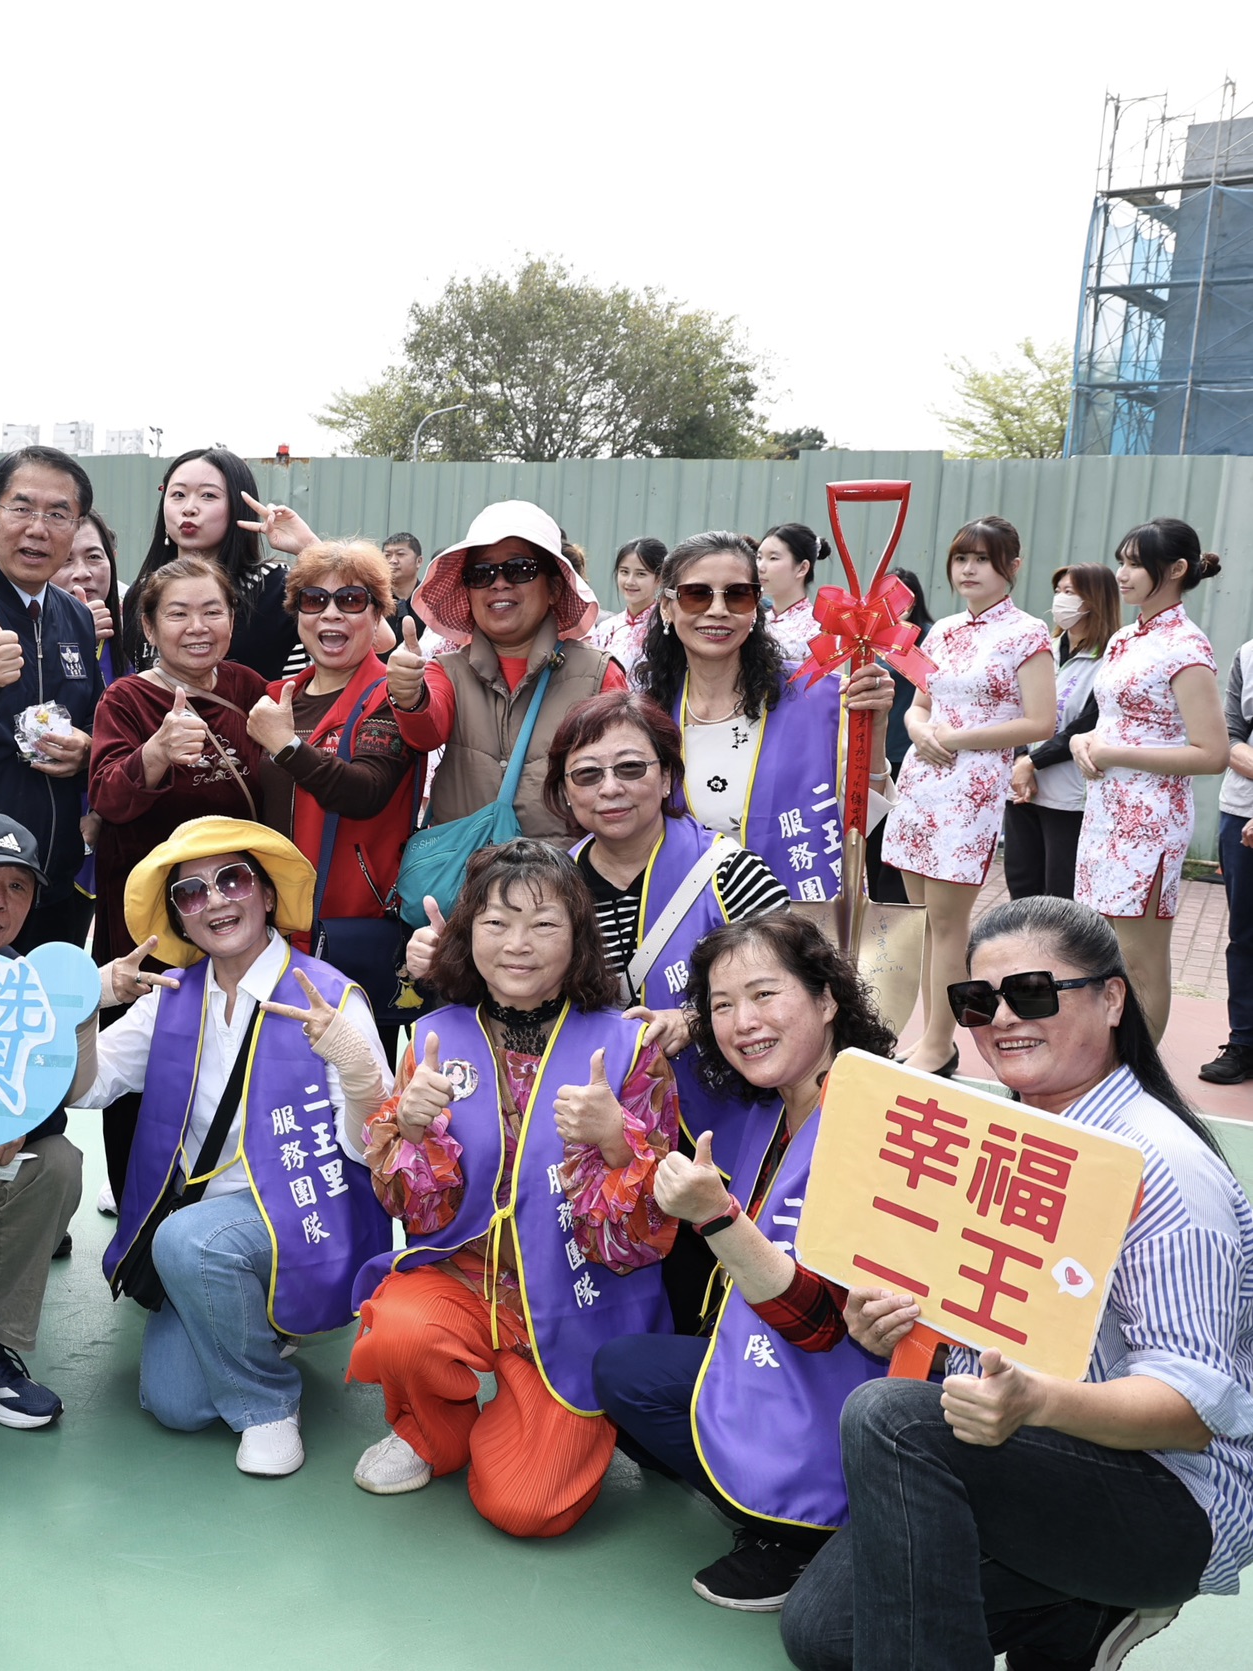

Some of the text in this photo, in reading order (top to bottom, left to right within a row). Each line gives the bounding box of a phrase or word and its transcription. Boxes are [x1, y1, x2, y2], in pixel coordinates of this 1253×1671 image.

[271, 1105, 330, 1244] 服務團隊
[303, 1084, 349, 1198] 二王里
[879, 1095, 1079, 1244] 幸福
[852, 1195, 1044, 1346] 二王
